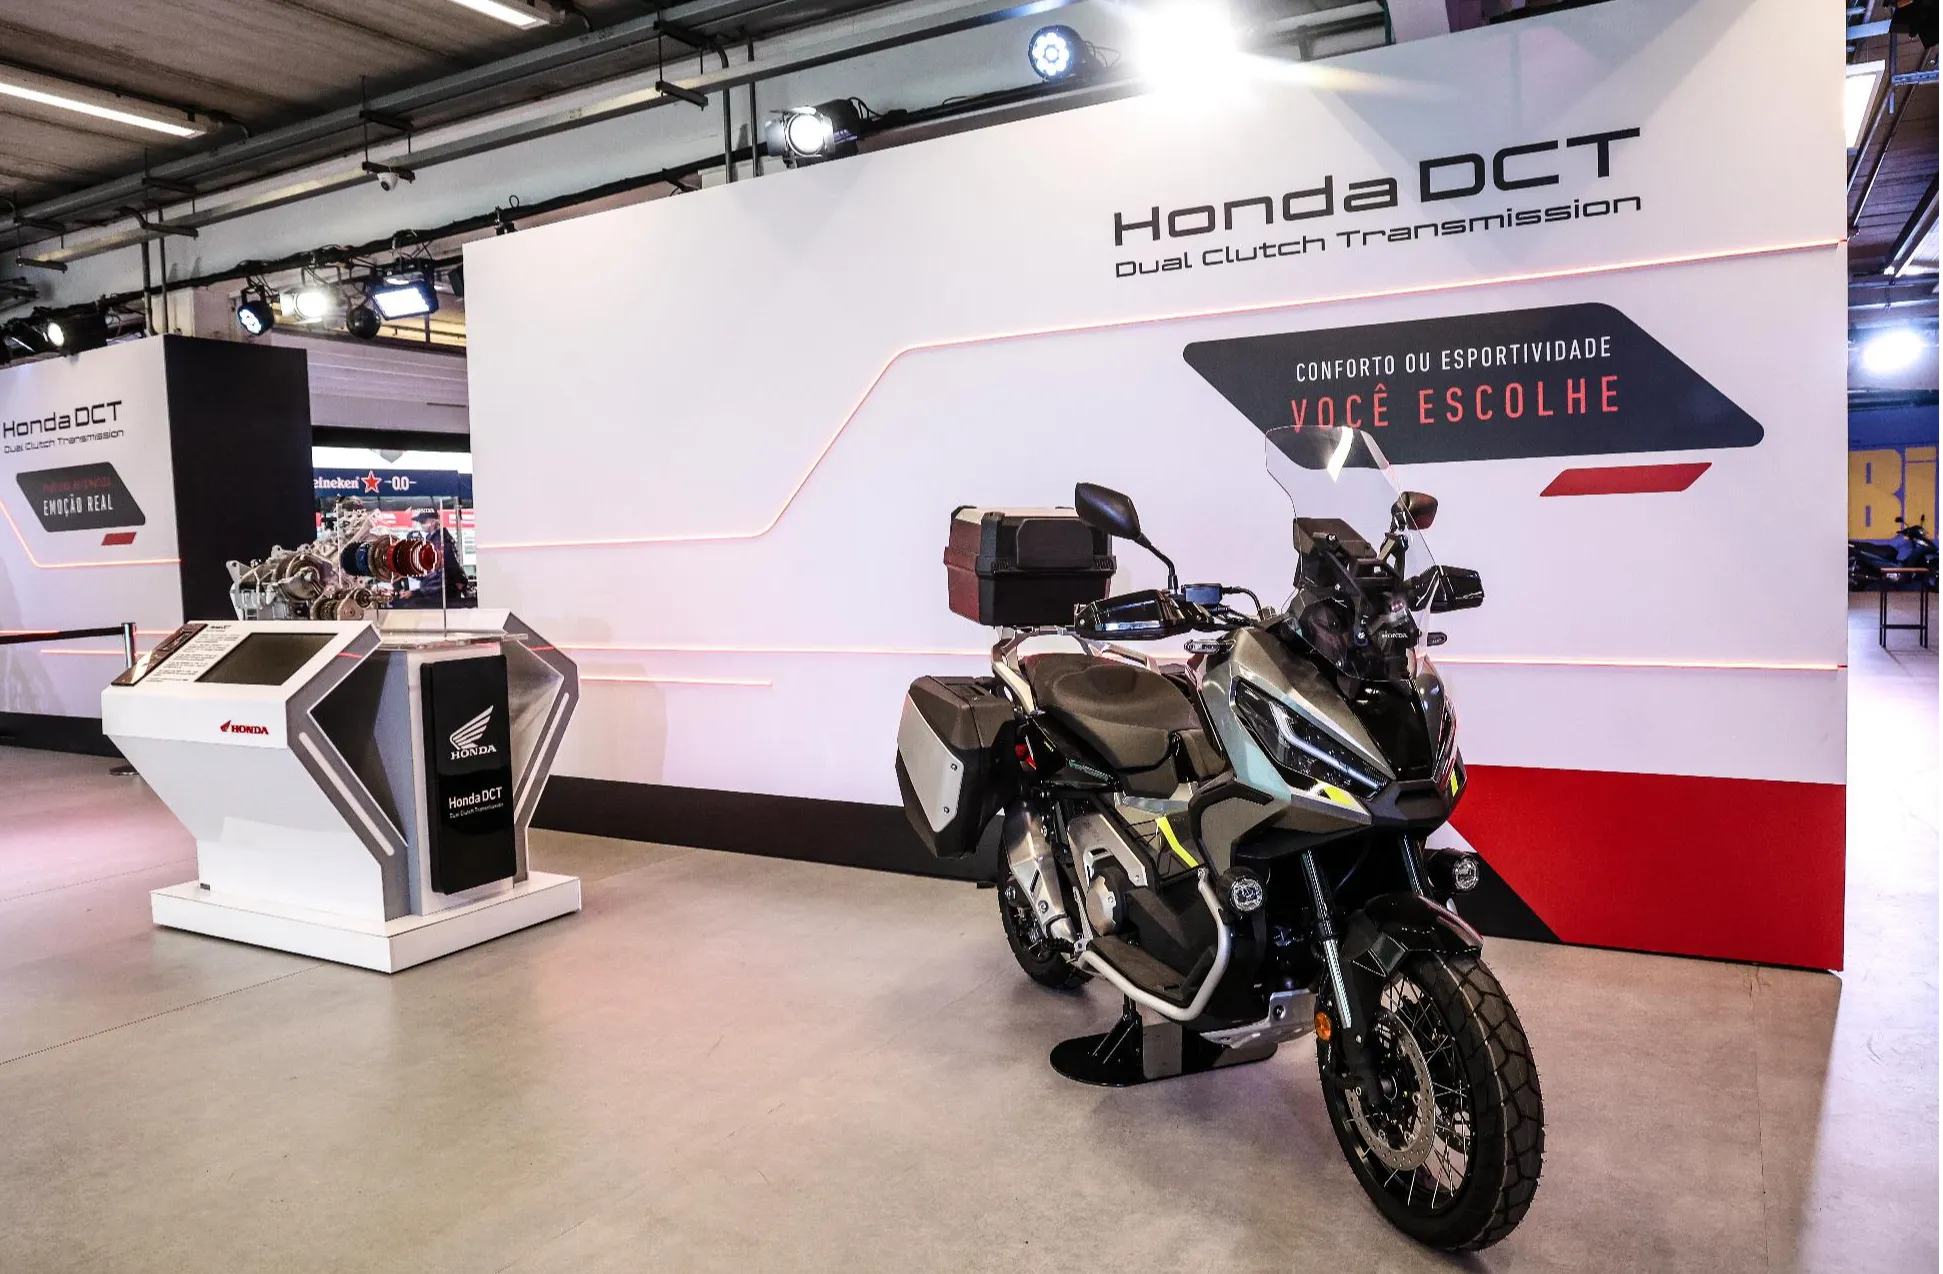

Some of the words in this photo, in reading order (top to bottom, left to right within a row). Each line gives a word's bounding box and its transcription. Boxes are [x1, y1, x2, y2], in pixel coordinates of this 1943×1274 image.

[1113, 175, 1399, 247] Honda
[1418, 127, 1641, 203] DCT
[1115, 252, 1193, 278] Dual
[1201, 236, 1326, 267] Clutch
[1336, 196, 1642, 248] Transmission
[1296, 354, 1395, 383] CONFORTO
[1405, 351, 1430, 374] OU
[1441, 335, 1611, 371] ESPORTIVIDADE
[1291, 383, 1388, 432] VOCÊ
[1418, 375, 1619, 425] ESCOLHE
[3, 412, 71, 439] Honda
[75, 400, 122, 427] DCT
[4, 444, 24, 454] Dual
[24, 439, 56, 450] Clutch
[57, 429, 125, 445] Transmission
[313, 475, 360, 489] eineken
[43, 493, 83, 518] EMOÇÃO
[87, 494, 113, 512] REAL
[1381, 631, 1408, 639] HONDA
[231, 724, 269, 735] HONDA
[450, 744, 497, 760] HONDA
[448, 792, 481, 810] Honda
[481, 786, 503, 802] DCT
